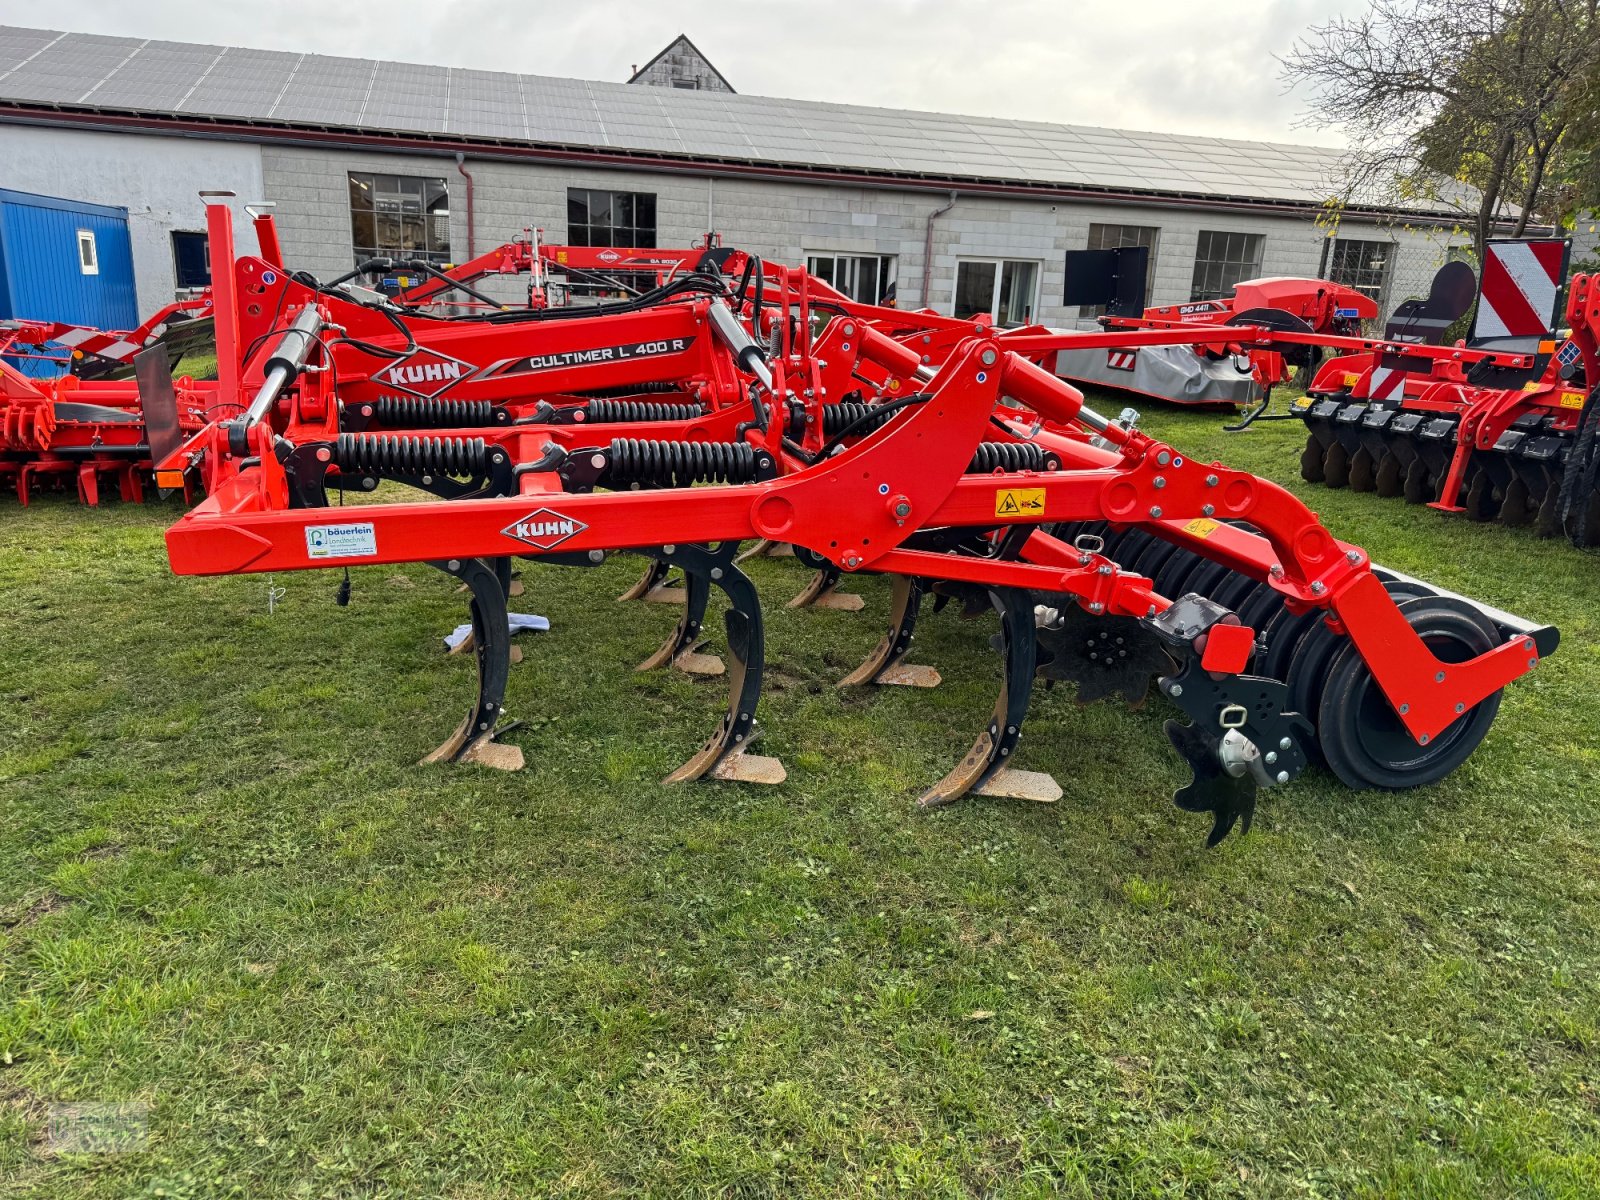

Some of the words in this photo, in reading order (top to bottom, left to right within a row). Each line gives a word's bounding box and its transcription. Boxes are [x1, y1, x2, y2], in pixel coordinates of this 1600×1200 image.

[530, 348, 613, 369] CULTIMER
[619, 346, 630, 357] L
[636, 341, 667, 355] 400
[673, 339, 684, 350] R
[388, 361, 461, 385] KUHN
[327, 526, 372, 536] bäuerlein
[516, 521, 574, 538] KUHN
